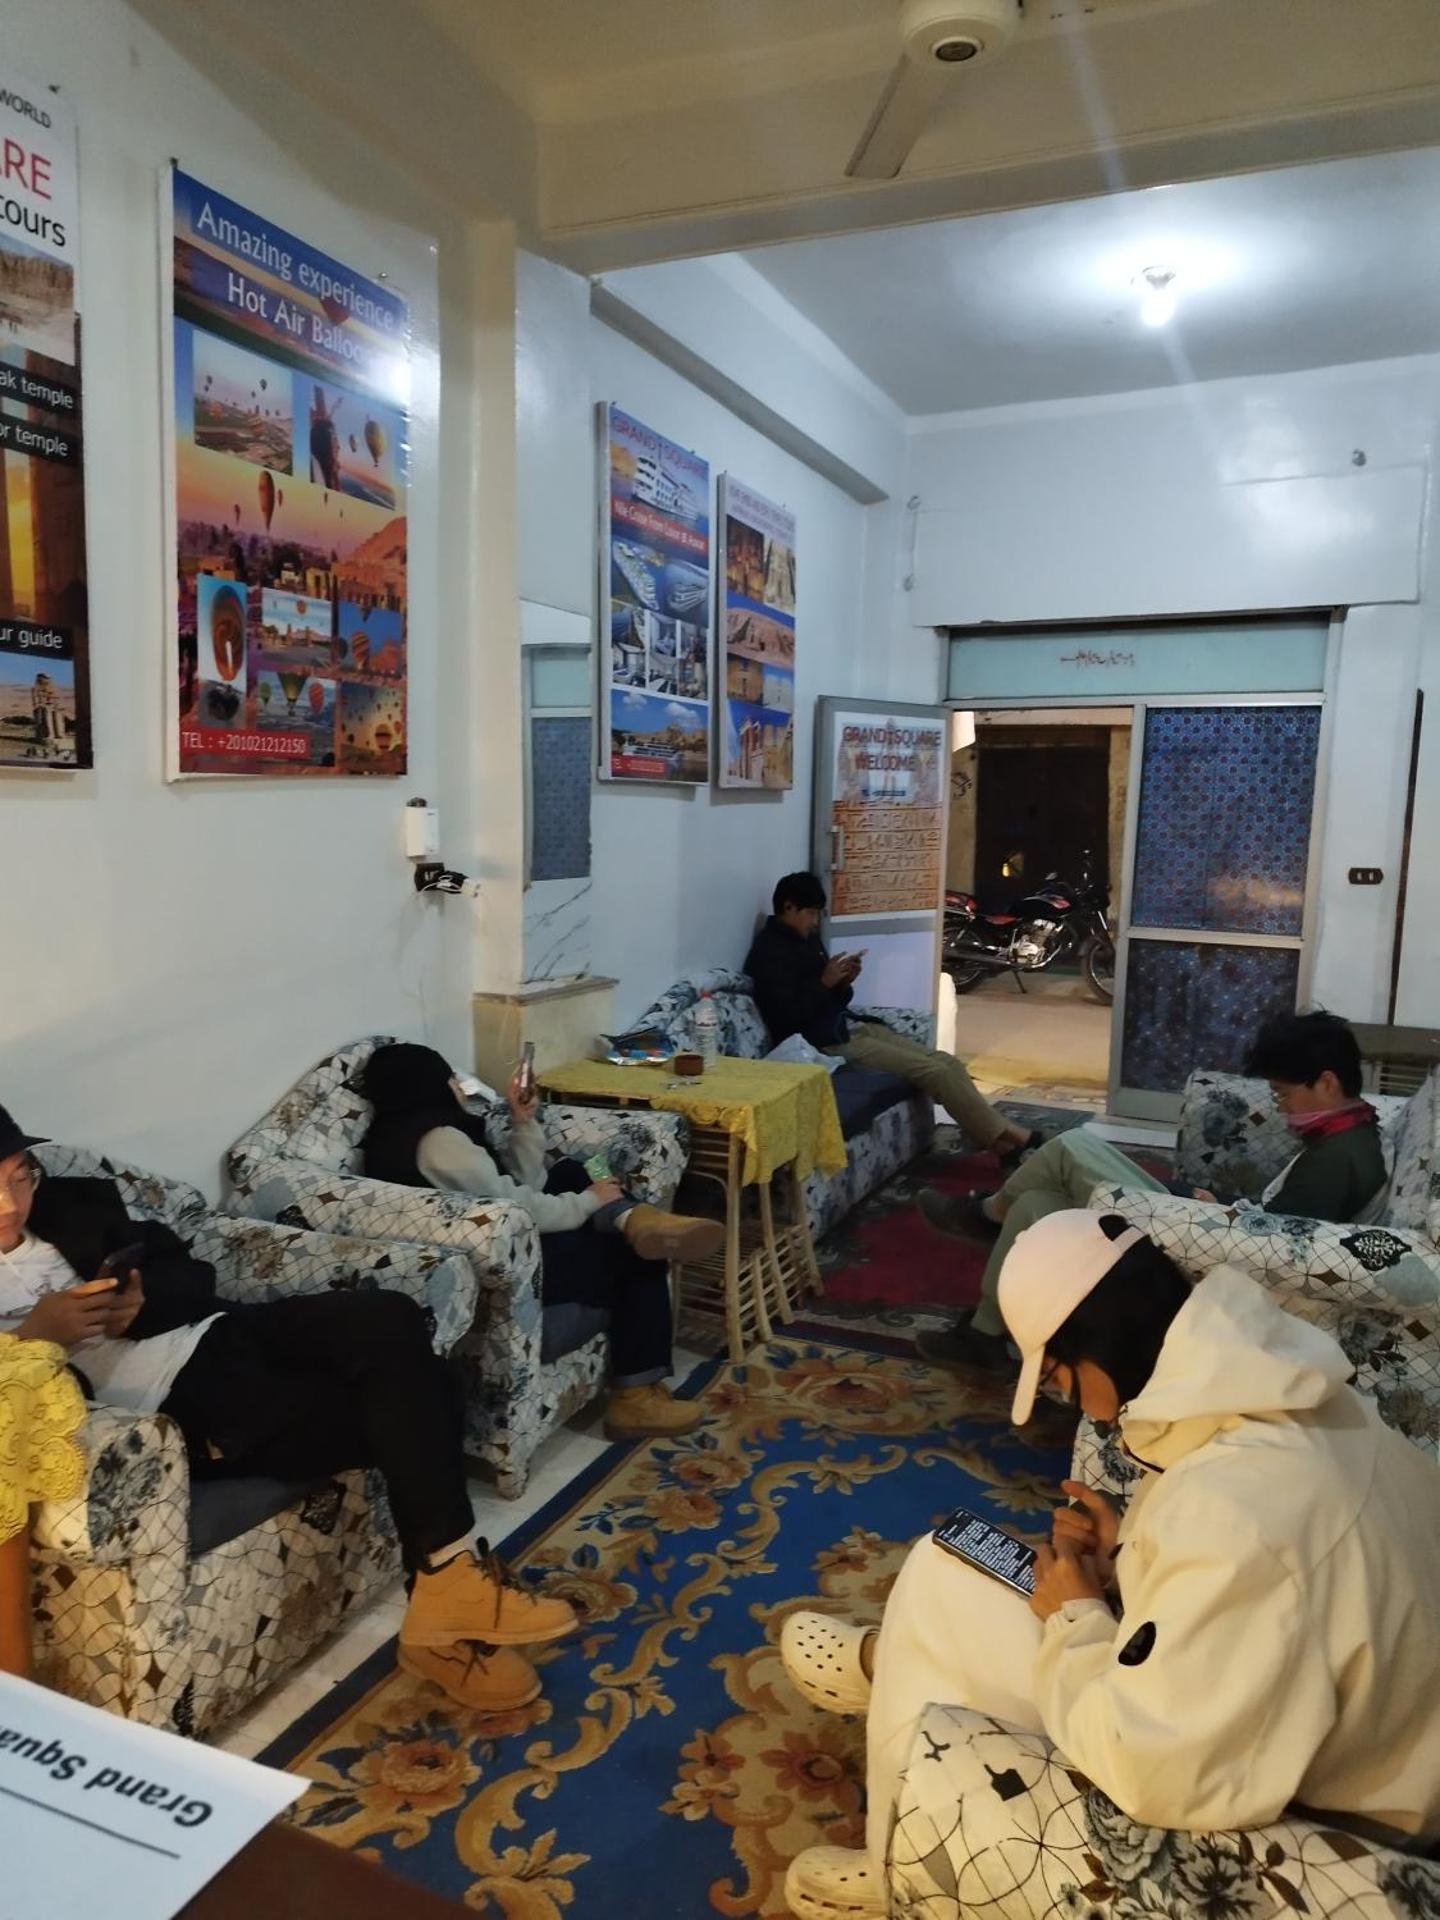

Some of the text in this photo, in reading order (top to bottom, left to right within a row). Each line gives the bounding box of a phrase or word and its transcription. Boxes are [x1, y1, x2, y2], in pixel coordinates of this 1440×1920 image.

[0, 138, 51, 200] RE
[197, 202, 393, 331] Amazing experience
[228, 272, 267, 318] Hot
[274, 300, 305, 335] Air
[21, 376, 73, 409] temple
[16, 425, 67, 456] temple
[19, 629, 63, 649] guide
[182, 731, 204, 749] TEL
[843, 726, 941, 748] GRAND SQUARE
[855, 752, 916, 771] WELCOME
[84, 1766, 213, 1828] Grand
